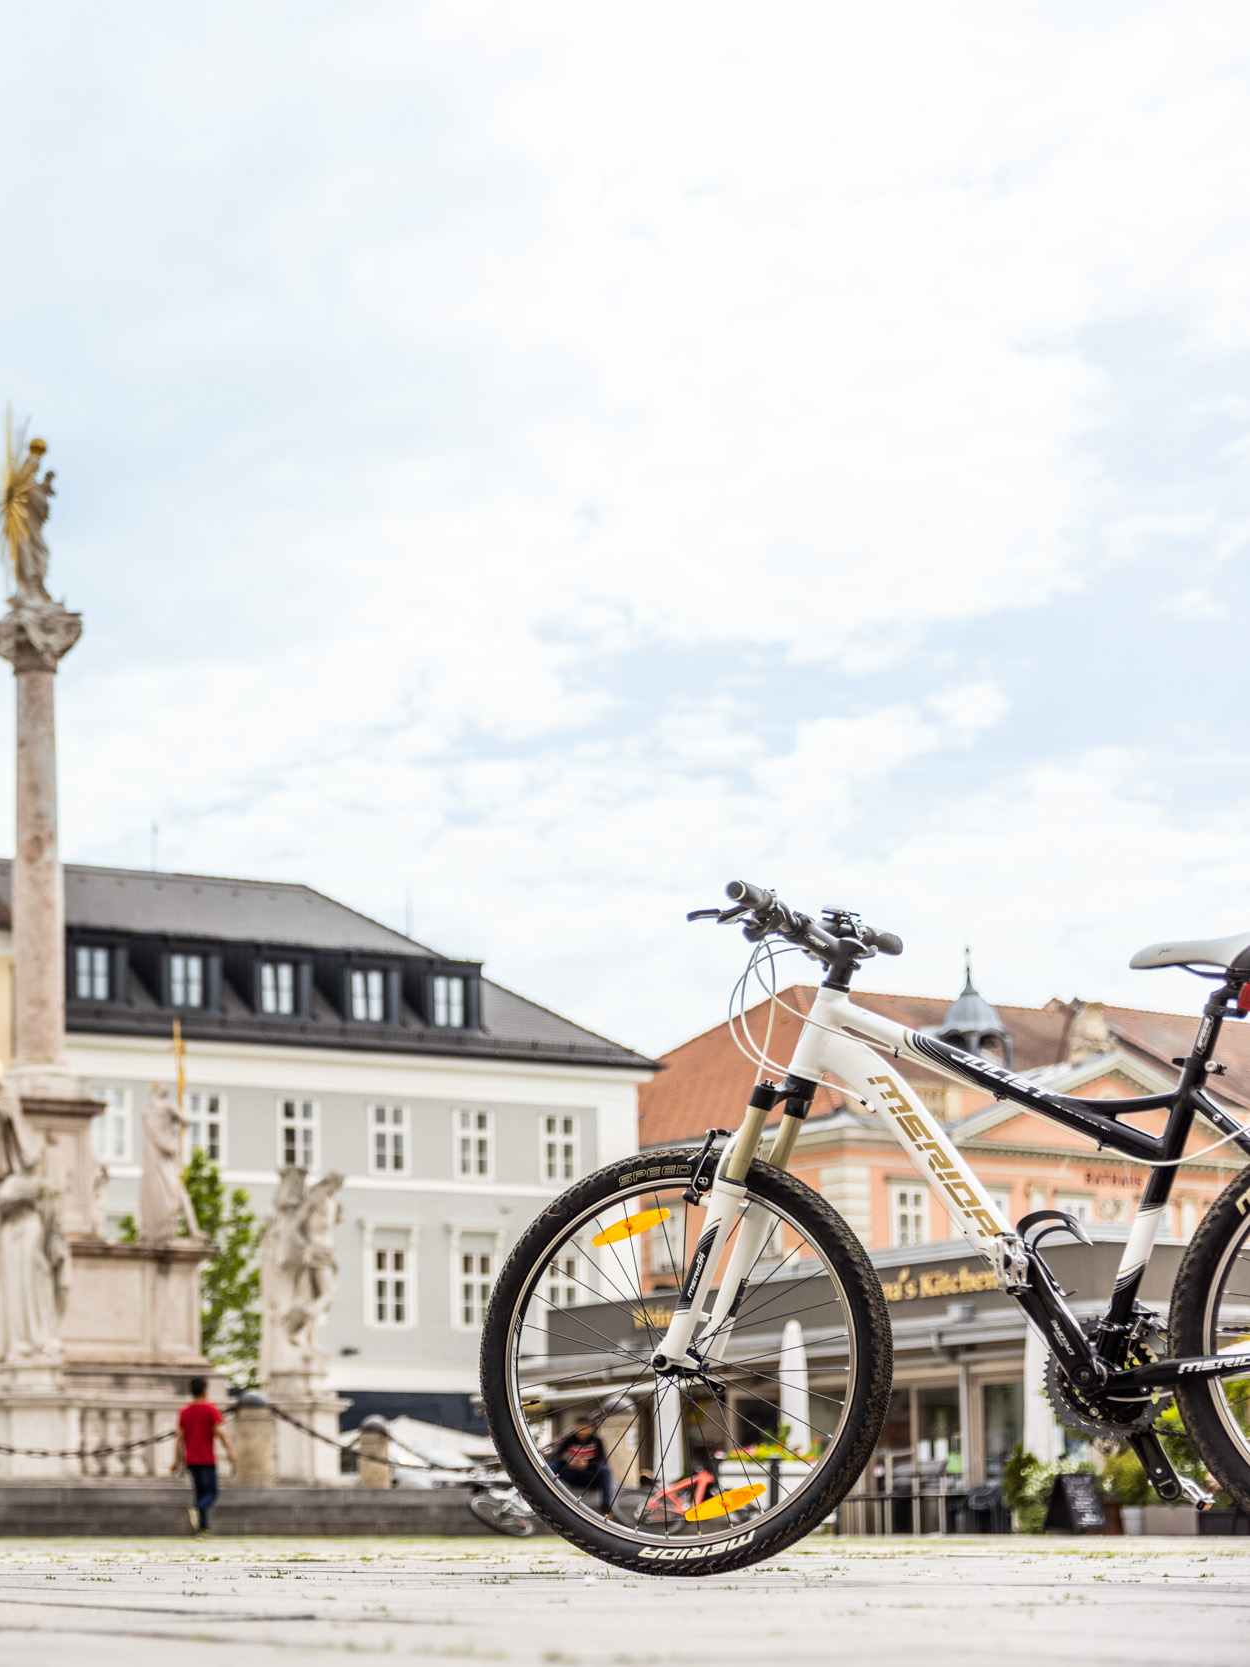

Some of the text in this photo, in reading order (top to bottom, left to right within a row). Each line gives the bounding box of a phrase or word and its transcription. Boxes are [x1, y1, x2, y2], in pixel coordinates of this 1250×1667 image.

[951, 1054, 1057, 1099] JULIET
[618, 1164, 692, 1188] SPEED
[867, 1075, 1003, 1238] MERIDA
[687, 1254, 706, 1299] MERIDA
[638, 1529, 756, 1560] MERIDA
